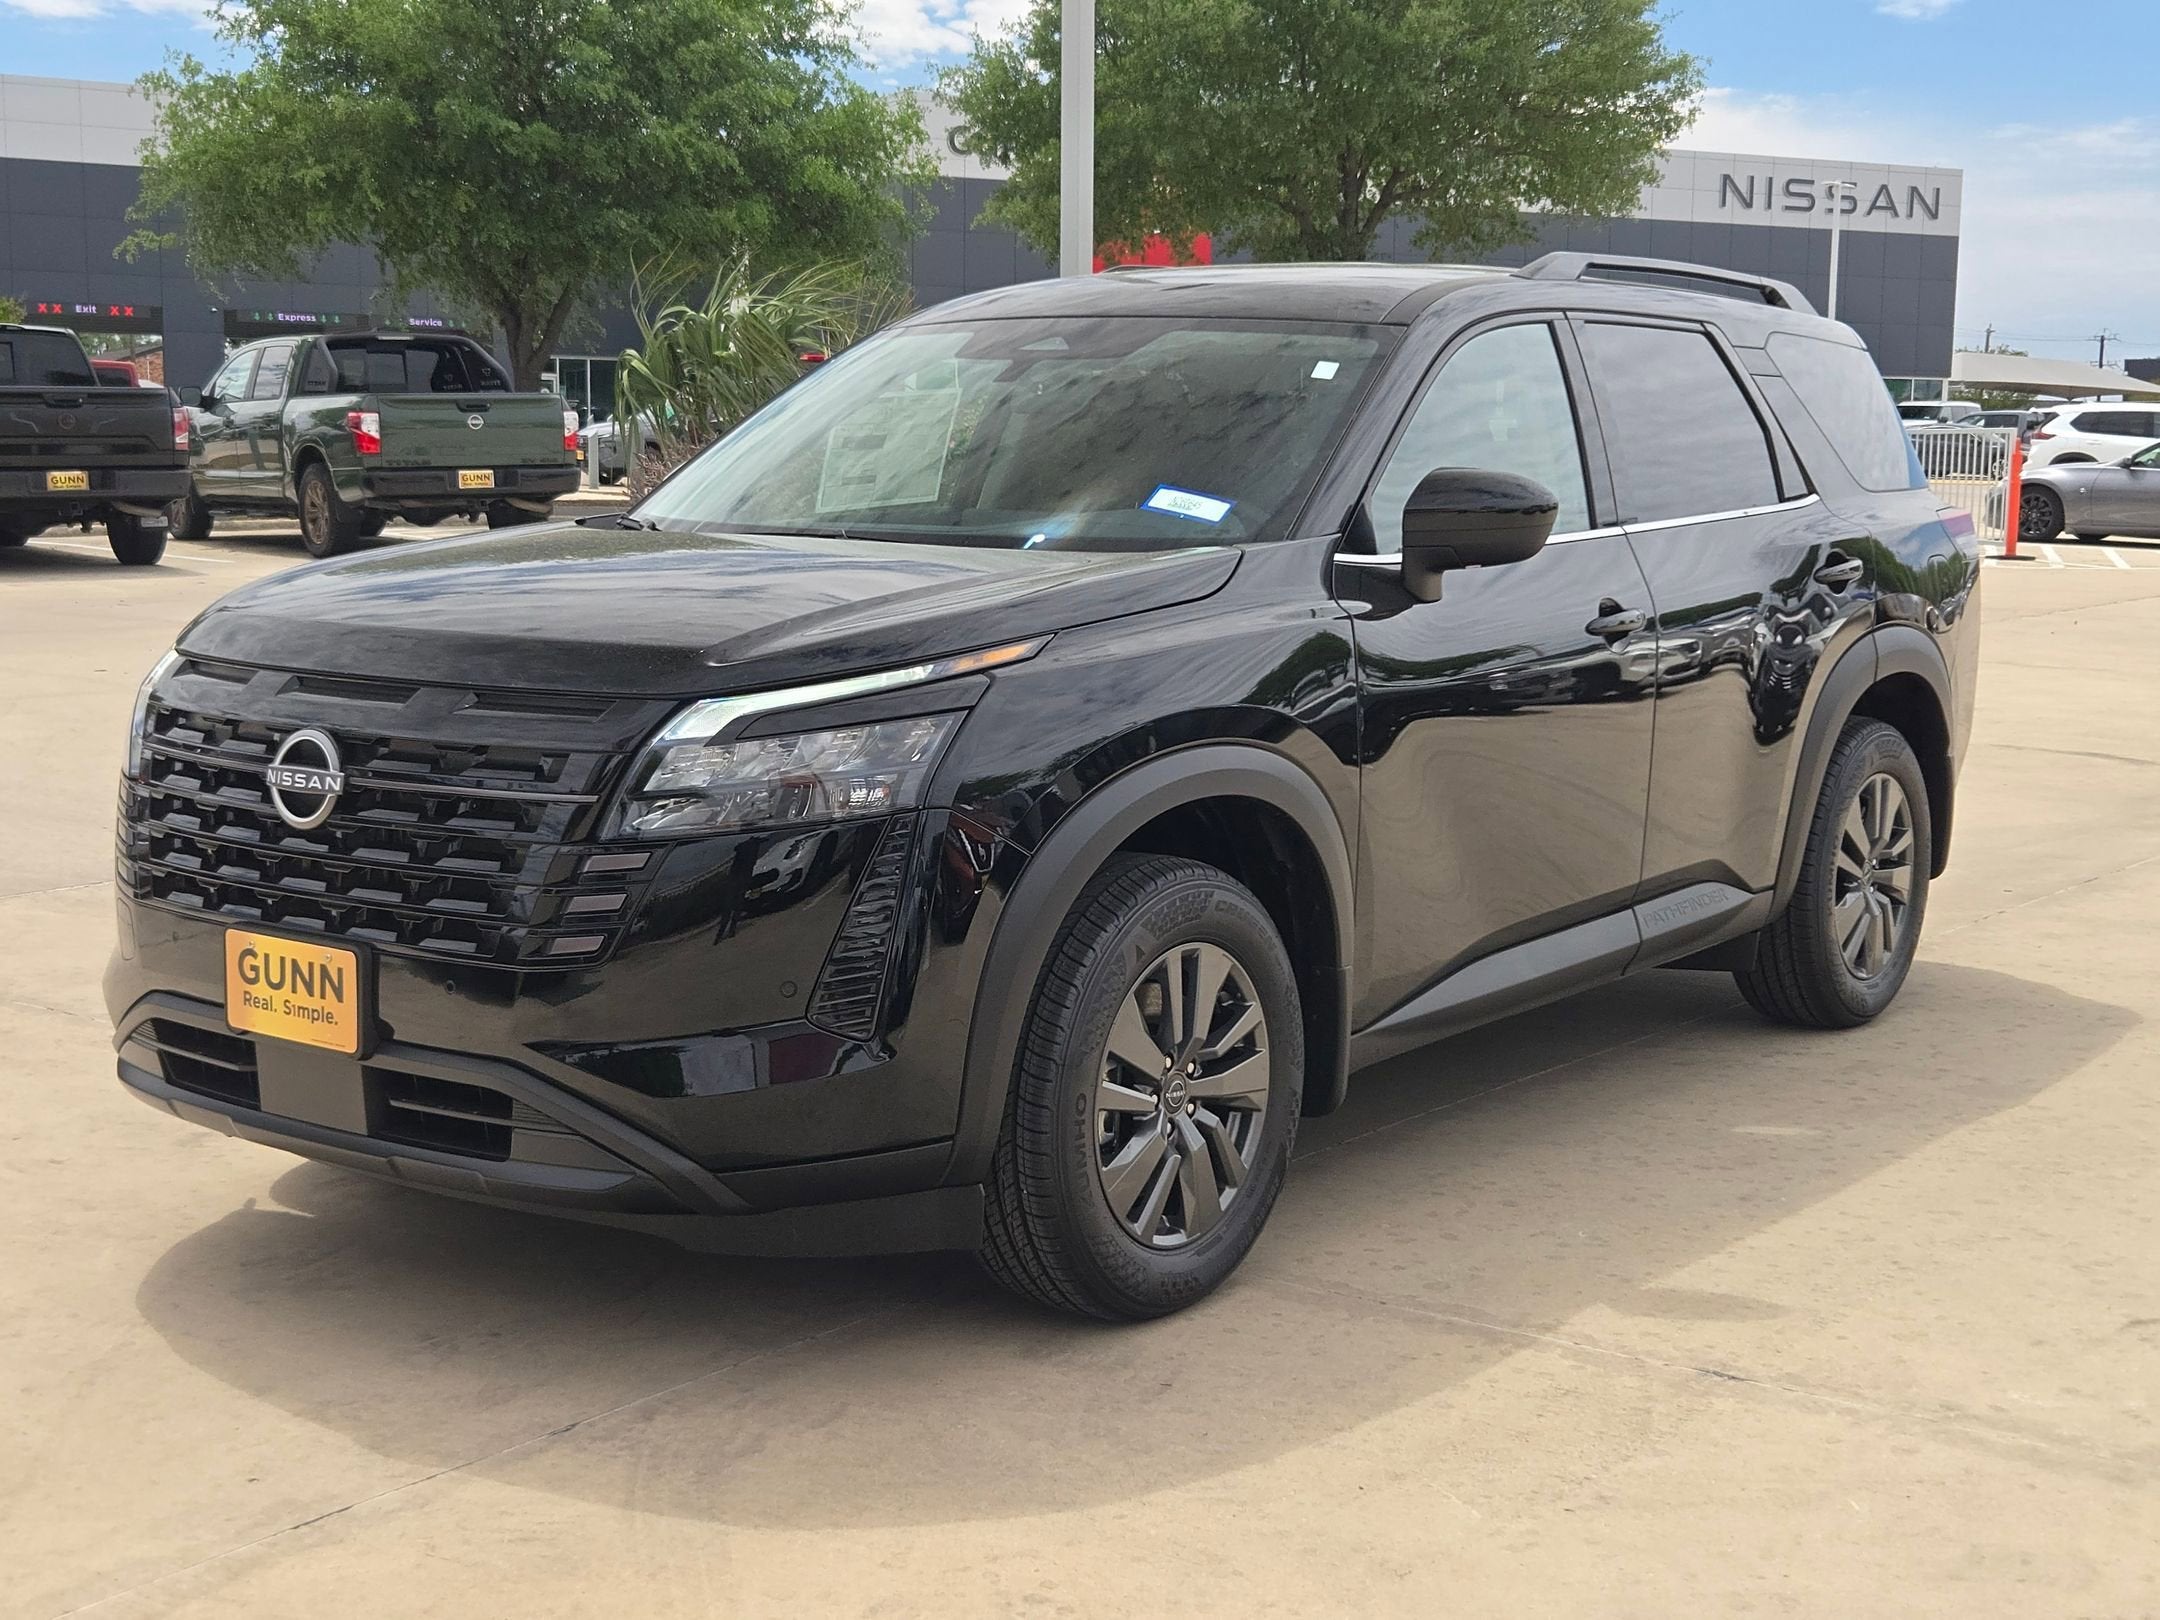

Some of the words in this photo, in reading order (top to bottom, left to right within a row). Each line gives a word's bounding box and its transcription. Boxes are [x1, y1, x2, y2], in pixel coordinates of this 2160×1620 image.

[1719, 173, 1941, 221] NISSAN
[75, 304, 97, 313] Exit
[278, 313, 317, 323] Express
[409, 318, 443, 327] Service
[50, 475, 85, 485] GUNN
[462, 473, 491, 482] GUNN
[267, 768, 341, 791] NISSAN
[1643, 887, 1729, 929] PATHFINDER
[238, 948, 344, 1003] GUNN
[243, 991, 278, 1013] Real.
